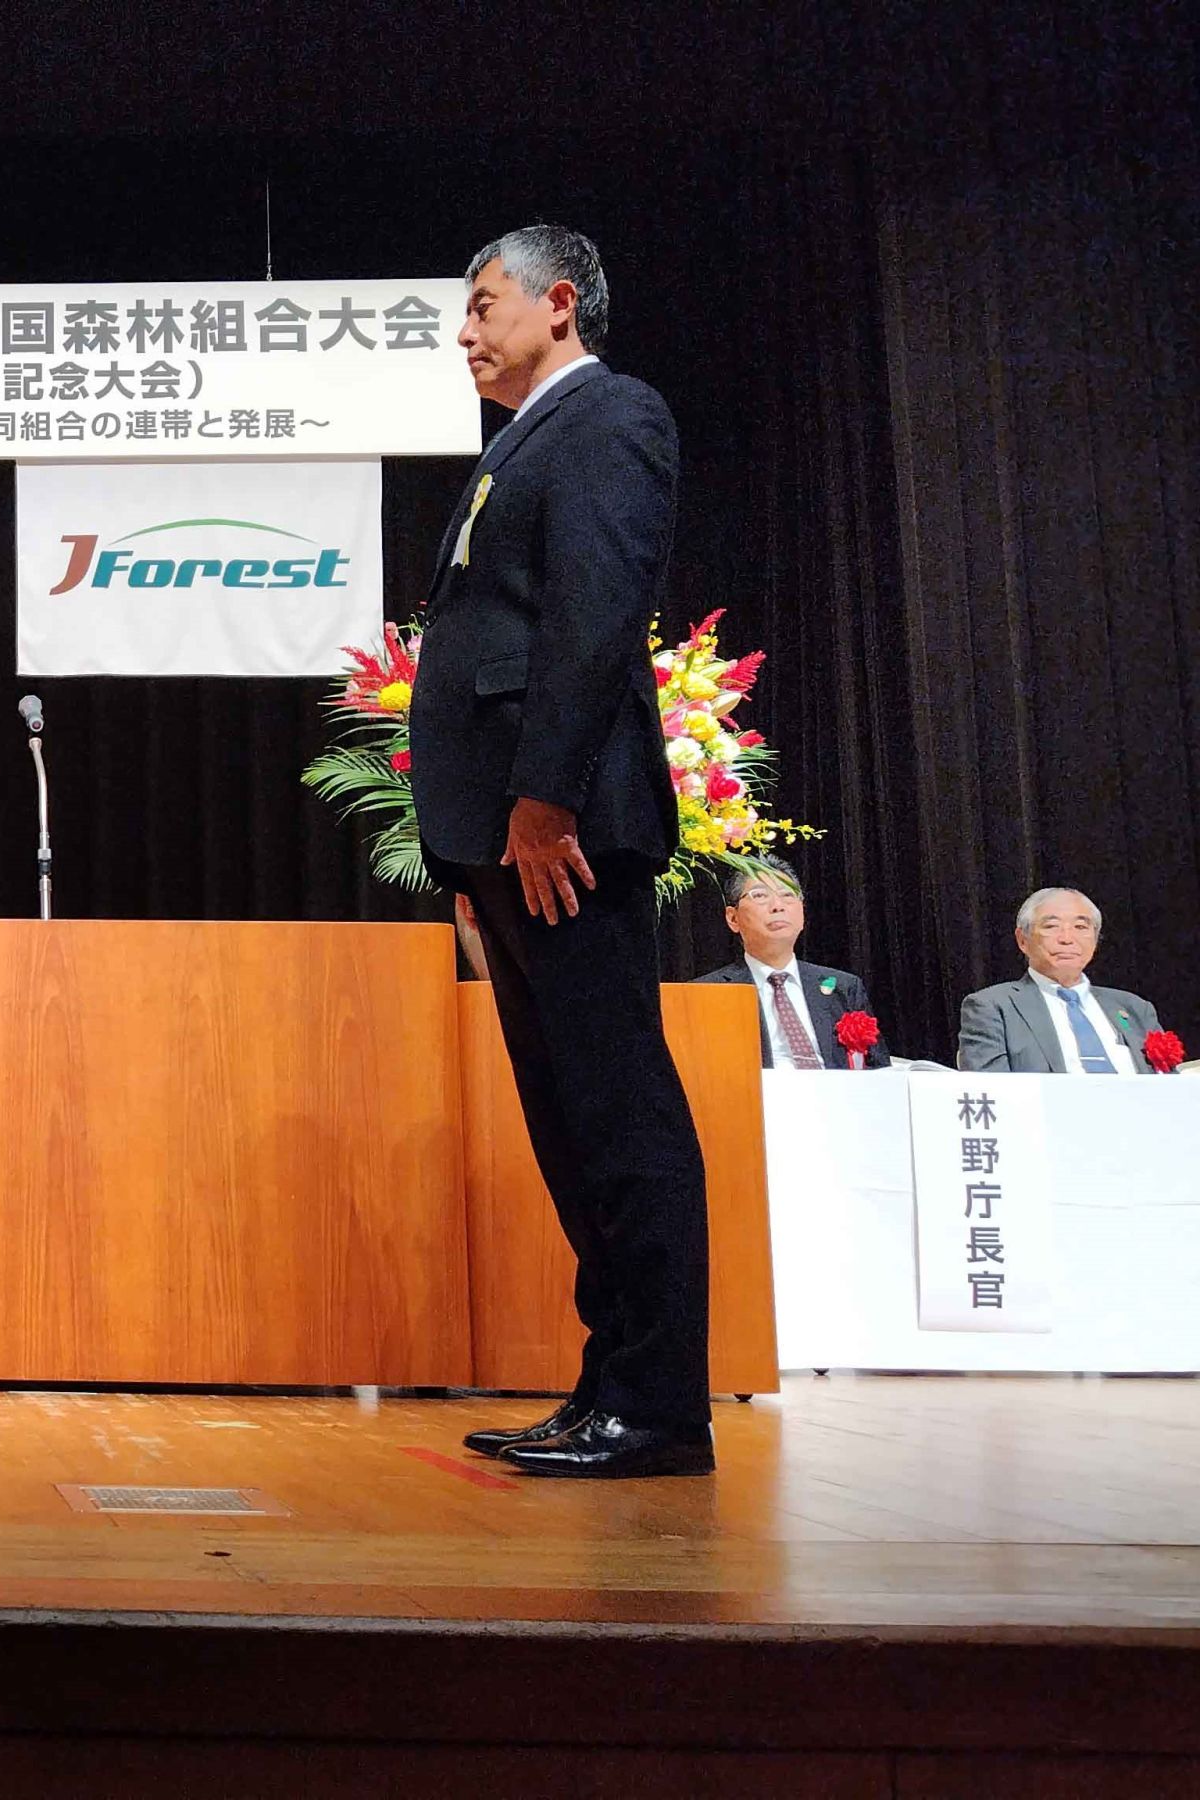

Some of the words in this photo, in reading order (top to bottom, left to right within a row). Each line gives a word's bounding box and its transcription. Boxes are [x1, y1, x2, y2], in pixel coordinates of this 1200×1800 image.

[49, 534, 350, 596] JForest
[957, 1092, 1005, 1309] 林野庁長官
